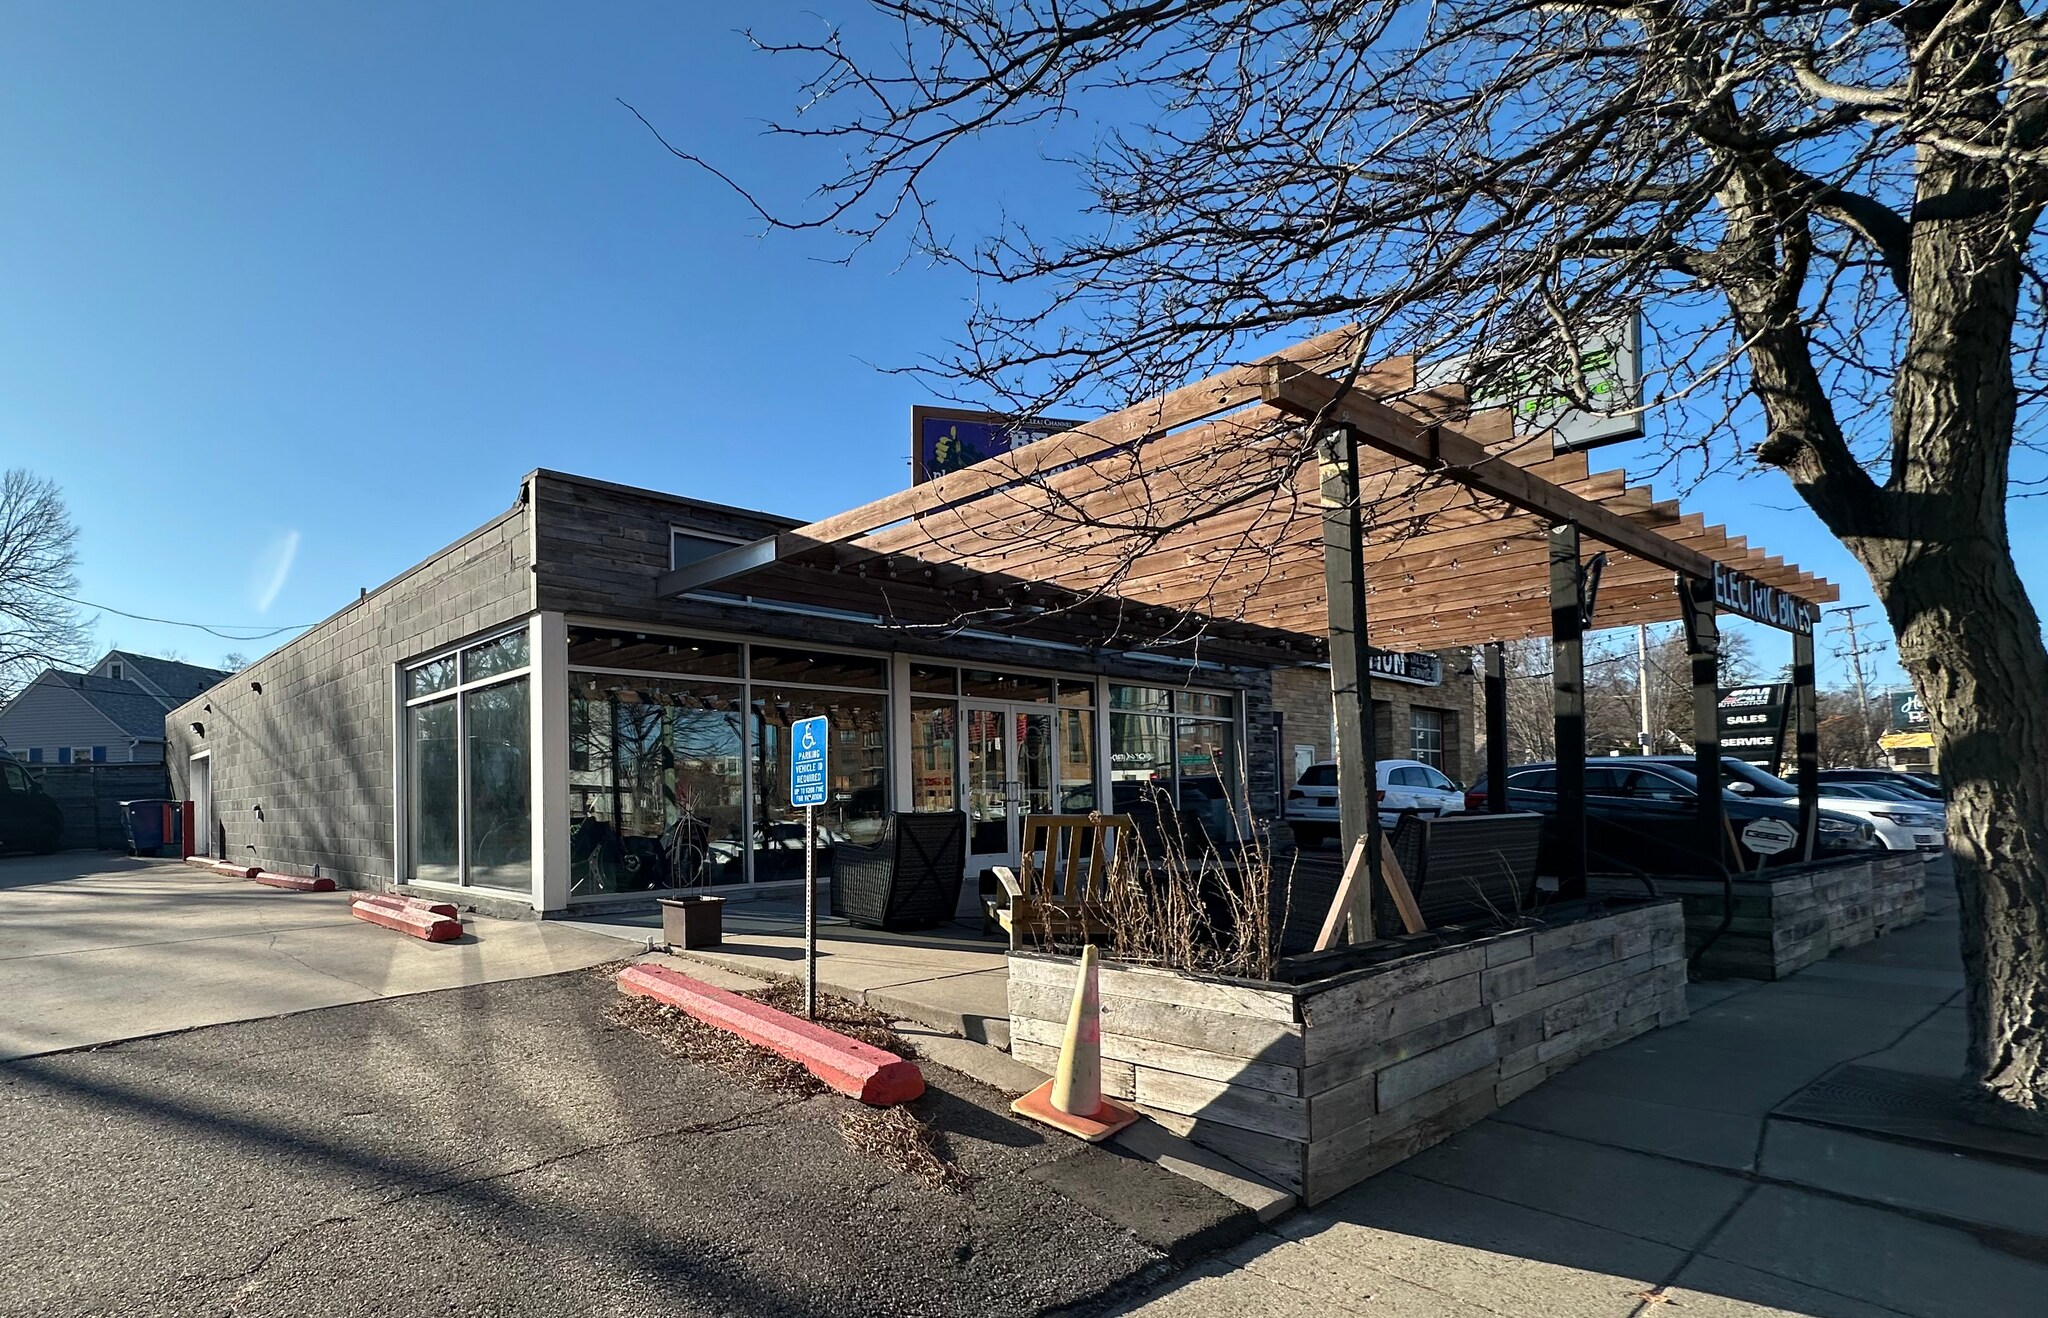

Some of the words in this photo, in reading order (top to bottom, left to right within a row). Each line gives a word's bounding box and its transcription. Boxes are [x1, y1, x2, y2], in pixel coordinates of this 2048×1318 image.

[1043, 418, 1073, 428] CHANNEL
[1713, 561, 1777, 623] ELECTRIC
[1778, 593, 1812, 634] BIKES
[1726, 714, 1767, 725] SALES
[1720, 736, 1774, 747] SERVICE
[798, 749, 821, 761] PARKING
[795, 763, 816, 774] VEHICLE
[817, 762, 823, 771] ID
[796, 773, 822, 784] REQUIRED
